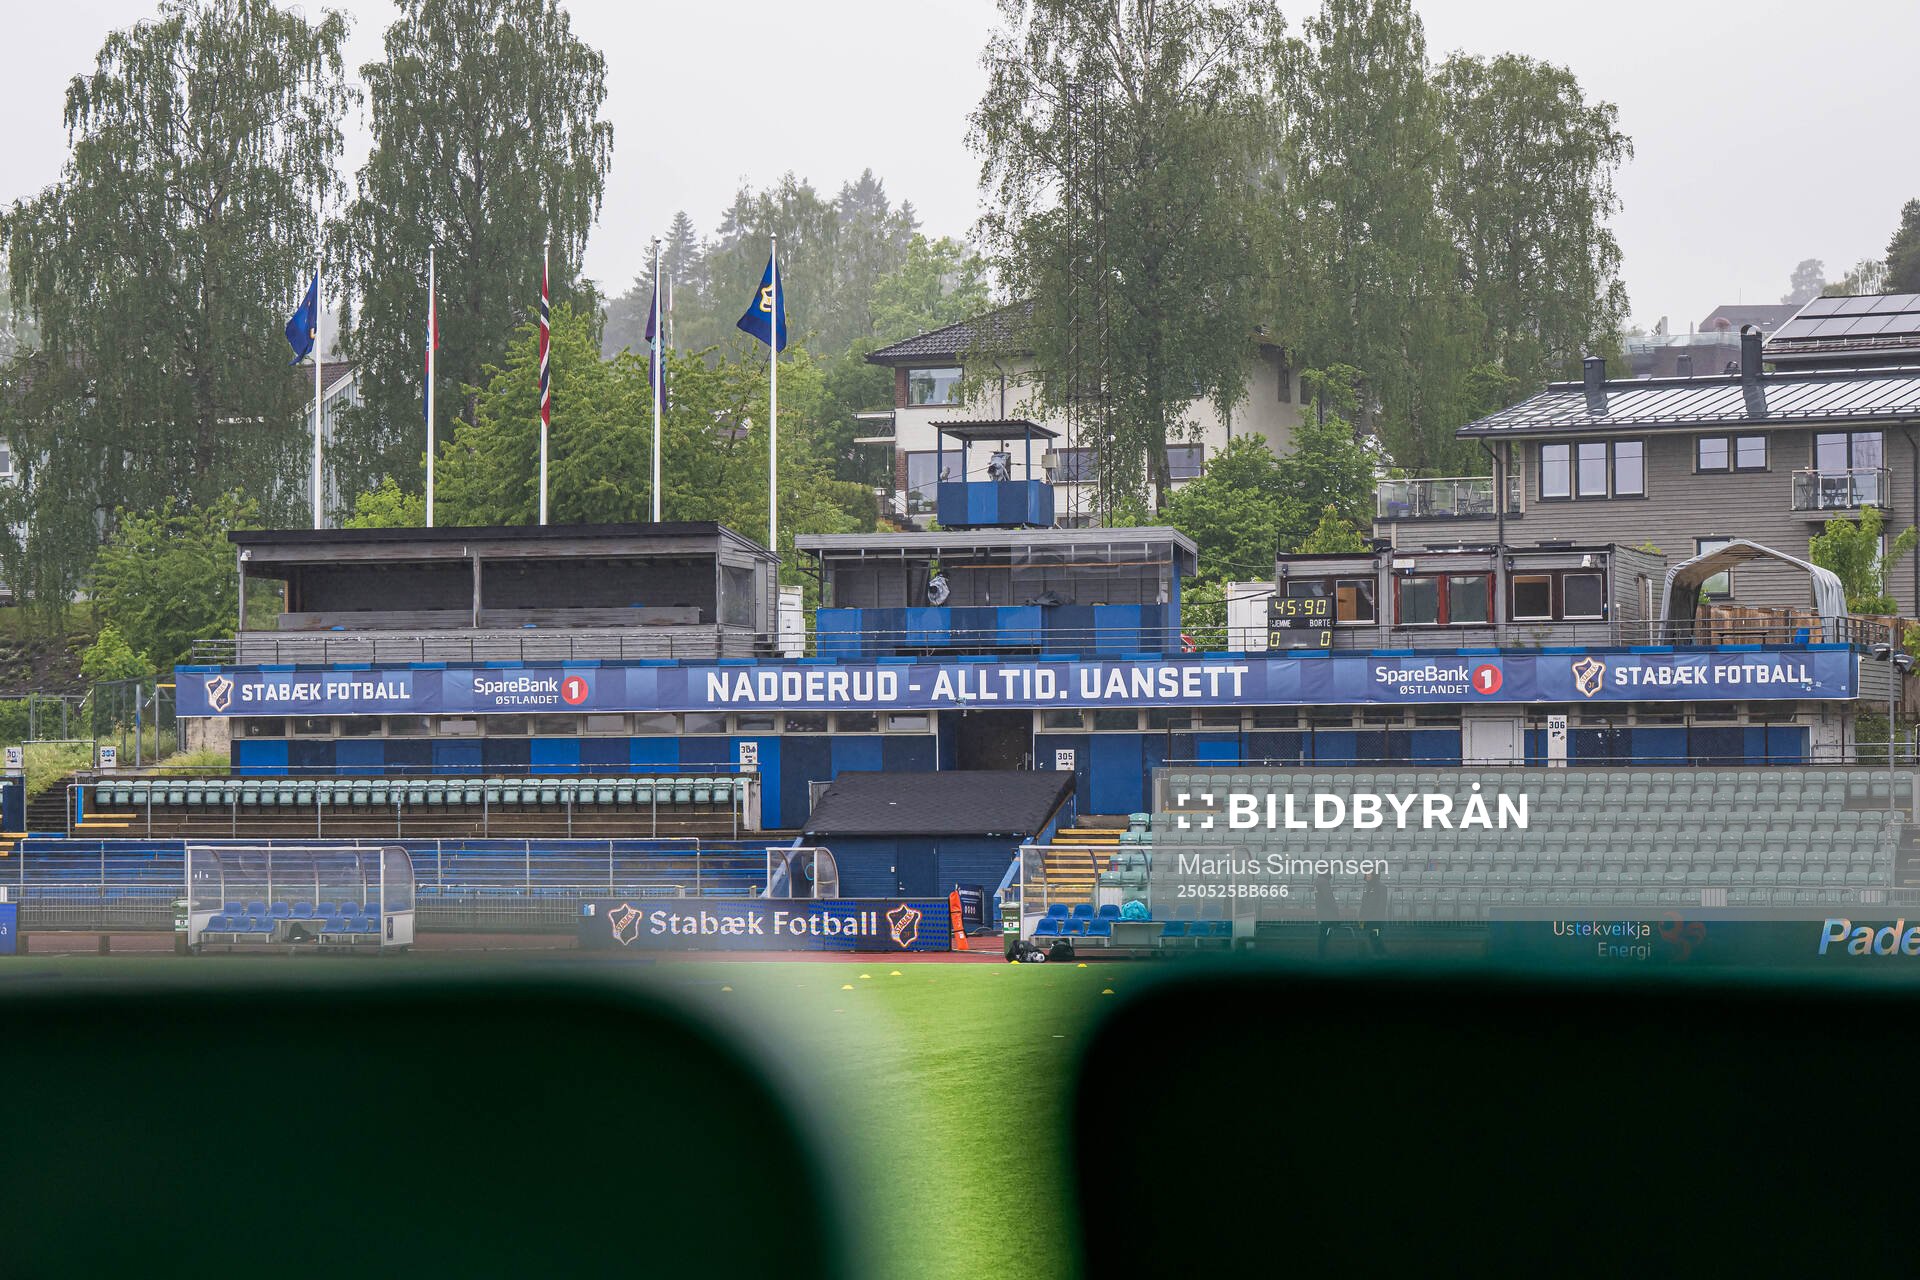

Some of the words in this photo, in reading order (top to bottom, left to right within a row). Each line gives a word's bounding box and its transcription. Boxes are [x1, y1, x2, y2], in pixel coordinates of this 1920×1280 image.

[1274, 599, 1327, 616] 45:90
[1309, 618, 1331, 628] BORTE
[1270, 631, 1281, 647] 0
[1320, 631, 1331, 647] 0
[707, 671, 898, 702] NADDERUD
[931, 669, 1068, 701] ALLTID.
[1080, 666, 1249, 699] UANSETT
[1375, 665, 1469, 686] SpareBank
[1480, 669, 1493, 689] 1
[1615, 665, 1708, 686] STABÆK
[1714, 664, 1813, 684] FOTBALL
[242, 682, 322, 701] STABÆK
[327, 682, 410, 700] FOTBALL
[474, 677, 558, 696] SpareBank
[568, 680, 580, 700] 1
[1399, 684, 1470, 695] ØSTLANDET
[495, 695, 559, 705] ØSTLANDET
[1549, 721, 1565, 729] 306
[1057, 752, 1073, 760] 305
[649, 910, 765, 936] Stabæk
[773, 910, 878, 936] Fotball
[1553, 919, 1651, 940] Ustekveikja
[1817, 917, 1920, 956] Pade
[1598, 942, 1652, 960] Energi
